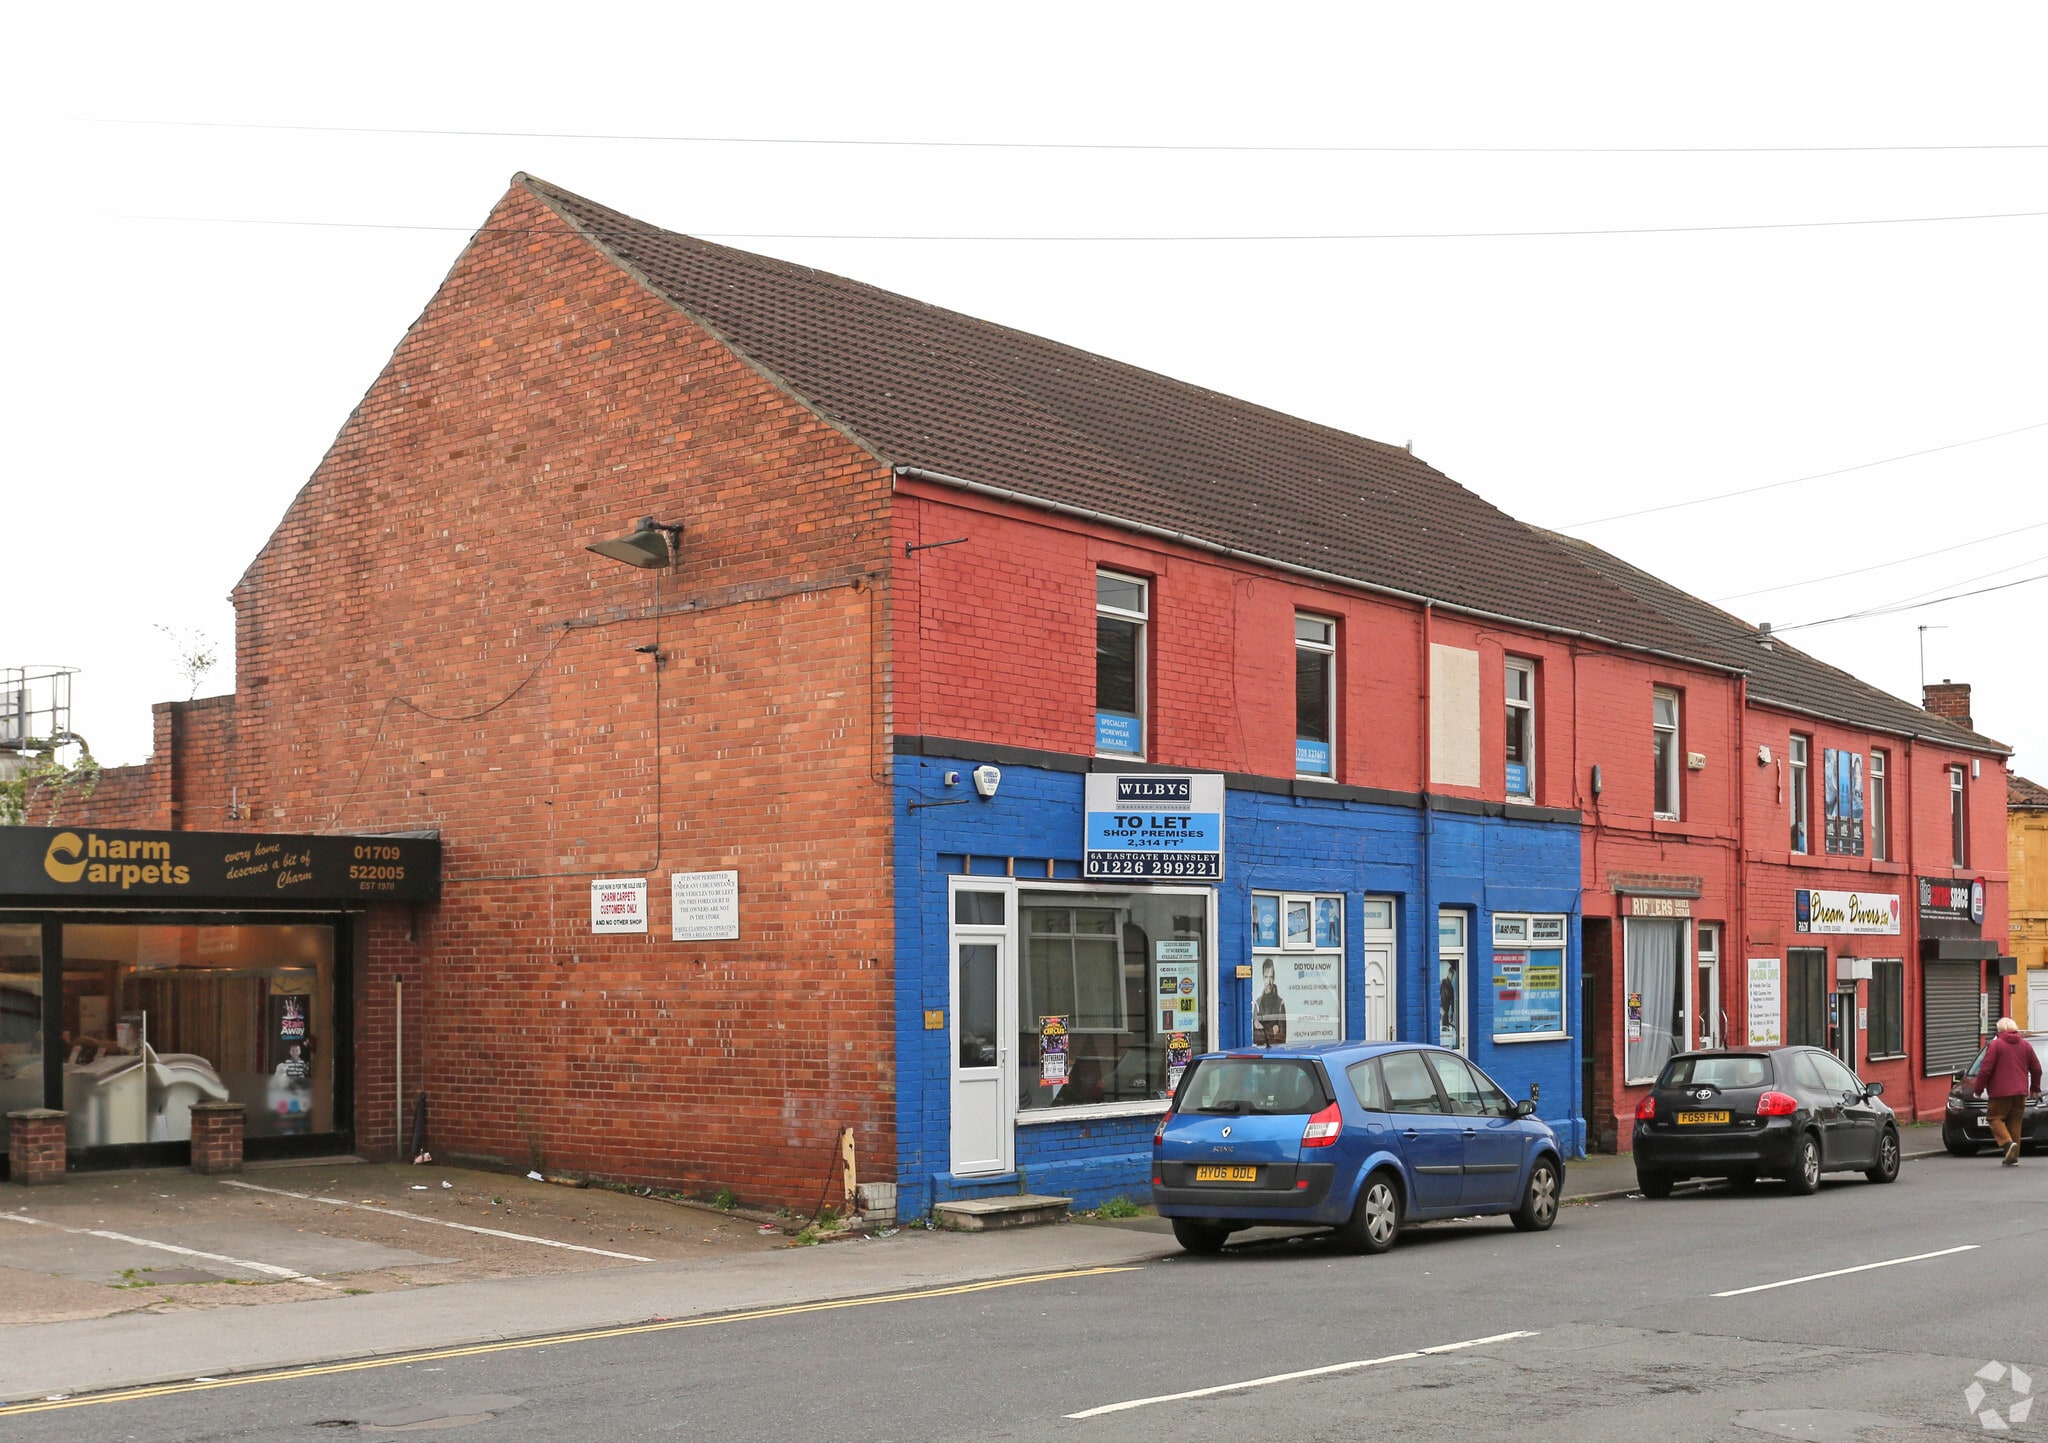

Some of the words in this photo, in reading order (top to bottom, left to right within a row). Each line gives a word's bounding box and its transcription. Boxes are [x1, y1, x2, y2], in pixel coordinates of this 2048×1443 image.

[1101, 718, 1128, 728] SPECIALIST
[1100, 728, 1129, 738] WORKWEAR
[1101, 737, 1128, 747] AVAILABLE
[1120, 783, 1188, 796] WILBYS
[1113, 816, 1143, 829] TO
[1151, 816, 1191, 829] LET
[1141, 830, 1204, 838] PREMISES
[1127, 839, 1160, 847] 2,314
[224, 850, 252, 863] every
[254, 842, 280, 856] home
[354, 846, 400, 860] 01709
[1163, 853, 1217, 861] BARNSLEY
[226, 862, 268, 880] deserves
[272, 860, 279, 869] a
[283, 853, 297, 867] bit
[300, 850, 310, 867] of
[1090, 861, 1144, 873] 01226
[1152, 862, 1217, 875] 299221
[350, 865, 405, 880] 522005
[276, 870, 312, 889] Charm
[360, 882, 376, 890] EST
[378, 882, 394, 890] 1970
[601, 892, 616, 902] CHARM
[617, 891, 636, 901] CARPETS
[1951, 887, 1968, 911] space
[600, 904, 625, 914] CUSTOMERS
[627, 904, 637, 914] ONLY
[1811, 892, 1845, 922] Dream
[1848, 894, 1880, 924] Divers
[1181, 999, 1192, 1011] CAT
[282, 1020, 304, 1028] Stain
[281, 1027, 305, 1036] Away
[1043, 1027, 1065, 1035] CIRCUS
[1682, 1113, 1706, 1122] FG59
[1707, 1112, 1726, 1121] FNJ
[1200, 1167, 1227, 1178] HY06
[1232, 1167, 1253, 1179] ODL
